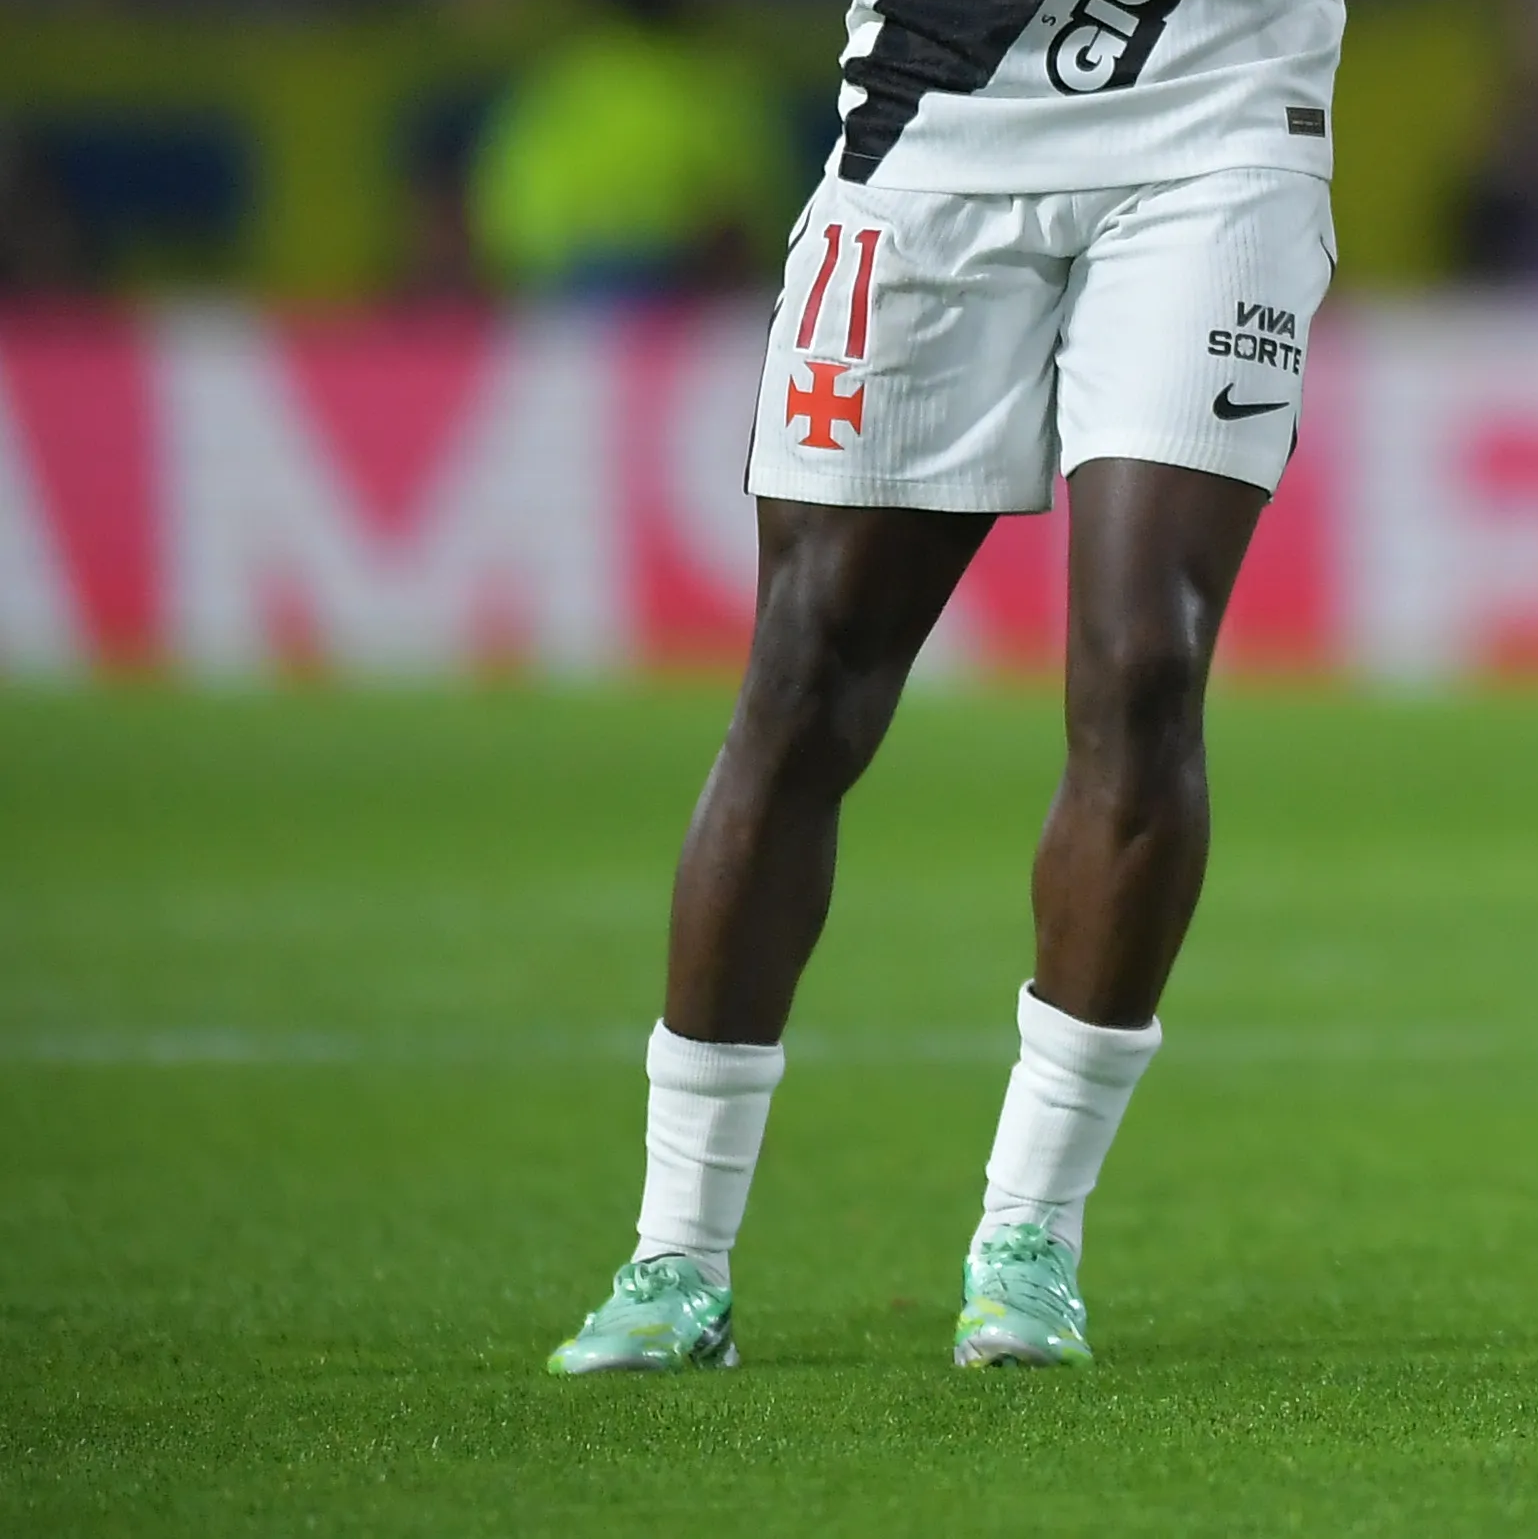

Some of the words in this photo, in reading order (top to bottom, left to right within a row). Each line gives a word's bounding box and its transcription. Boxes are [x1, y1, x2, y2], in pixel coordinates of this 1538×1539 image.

[793, 221, 884, 362] 11
[1236, 300, 1296, 340] VIVA
[1207, 329, 1302, 376] SORTE
